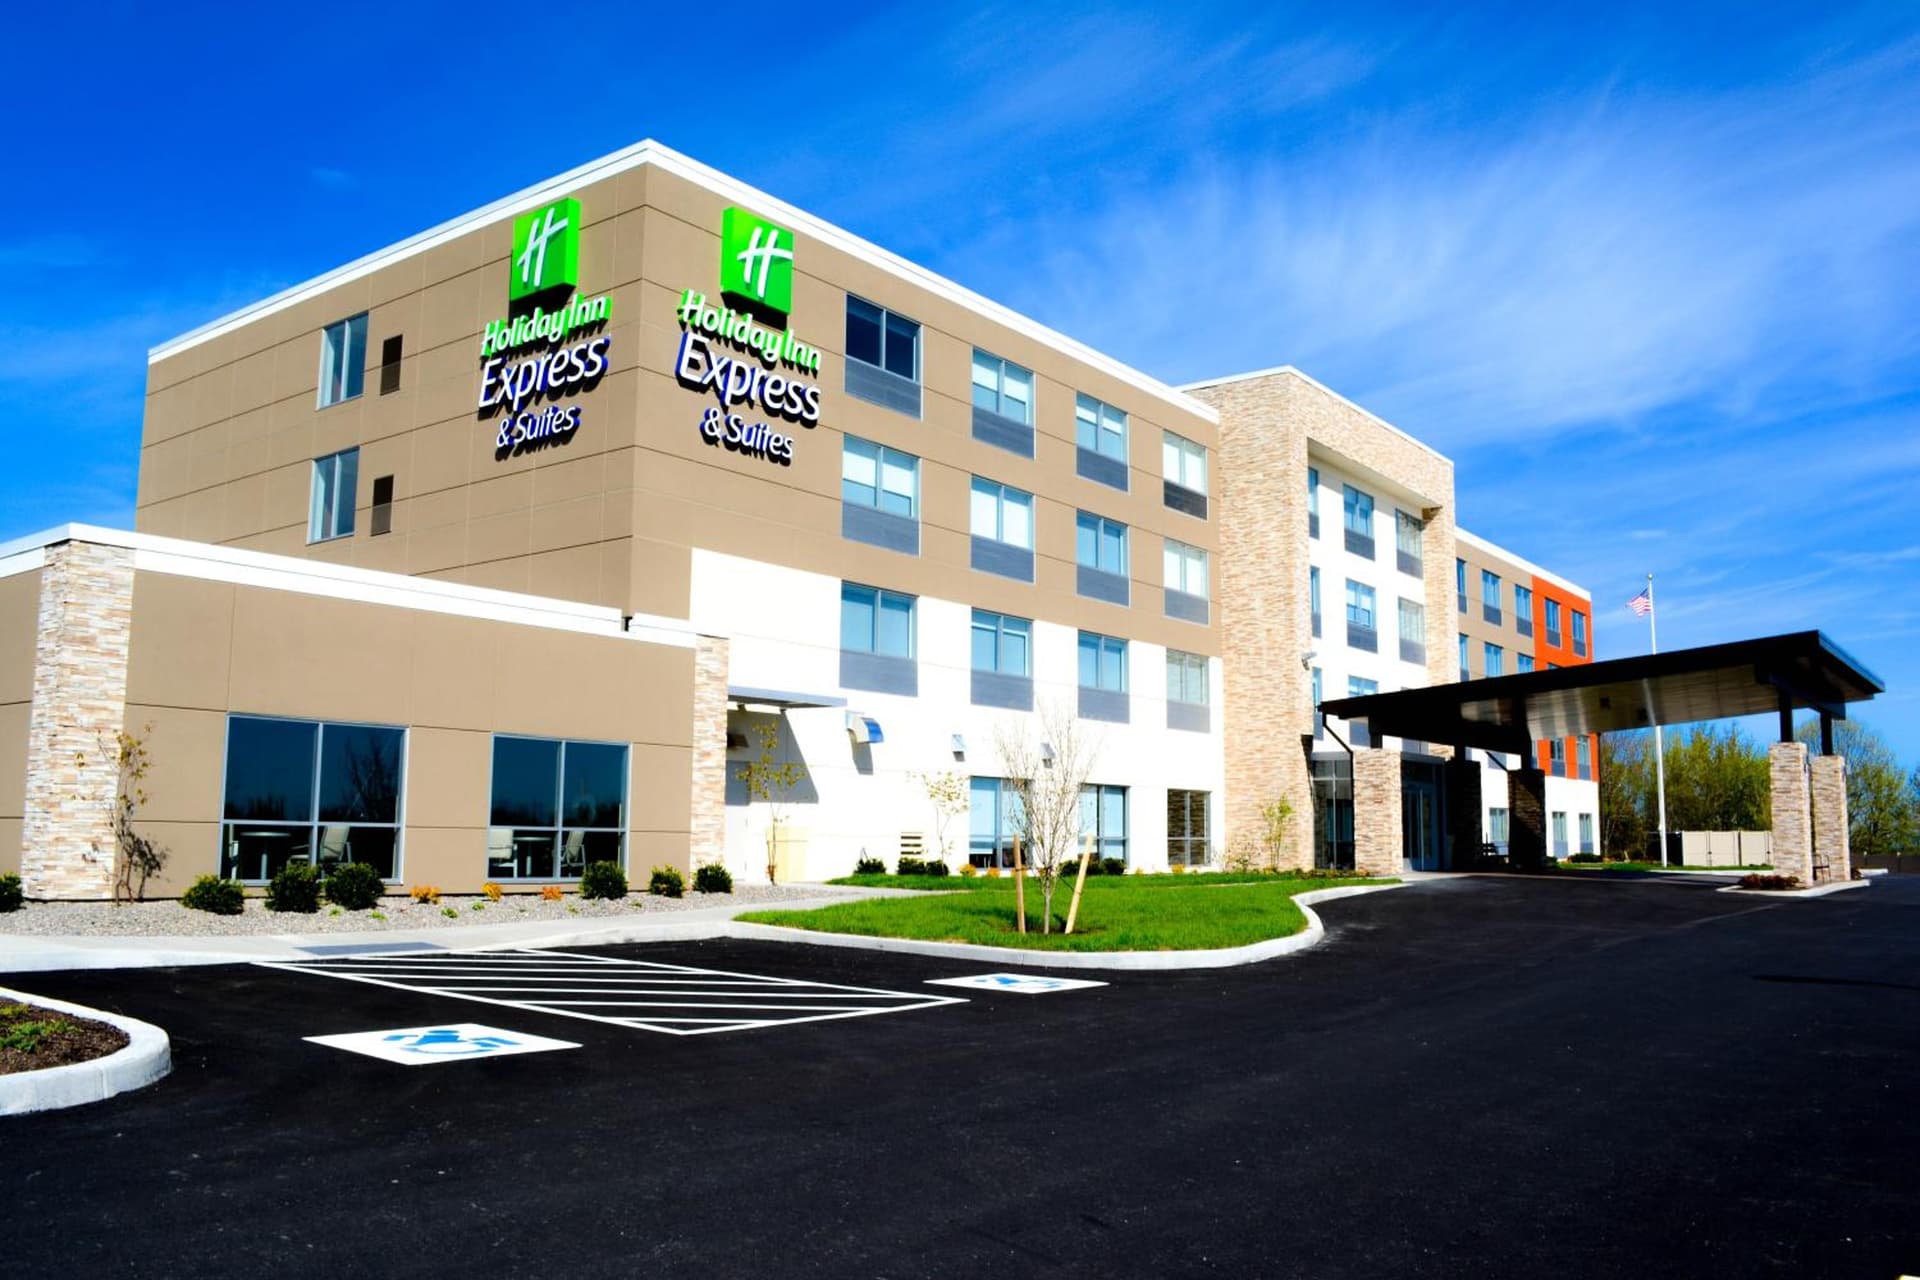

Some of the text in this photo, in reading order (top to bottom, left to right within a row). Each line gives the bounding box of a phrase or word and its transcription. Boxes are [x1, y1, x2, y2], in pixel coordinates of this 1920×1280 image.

[481, 293, 609, 357] Holiday Inn
[681, 289, 822, 370] Holiday Inn
[478, 337, 609, 412] Express
[679, 332, 821, 421] Express
[496, 406, 578, 448] & Suites
[702, 407, 794, 458] & Suites
